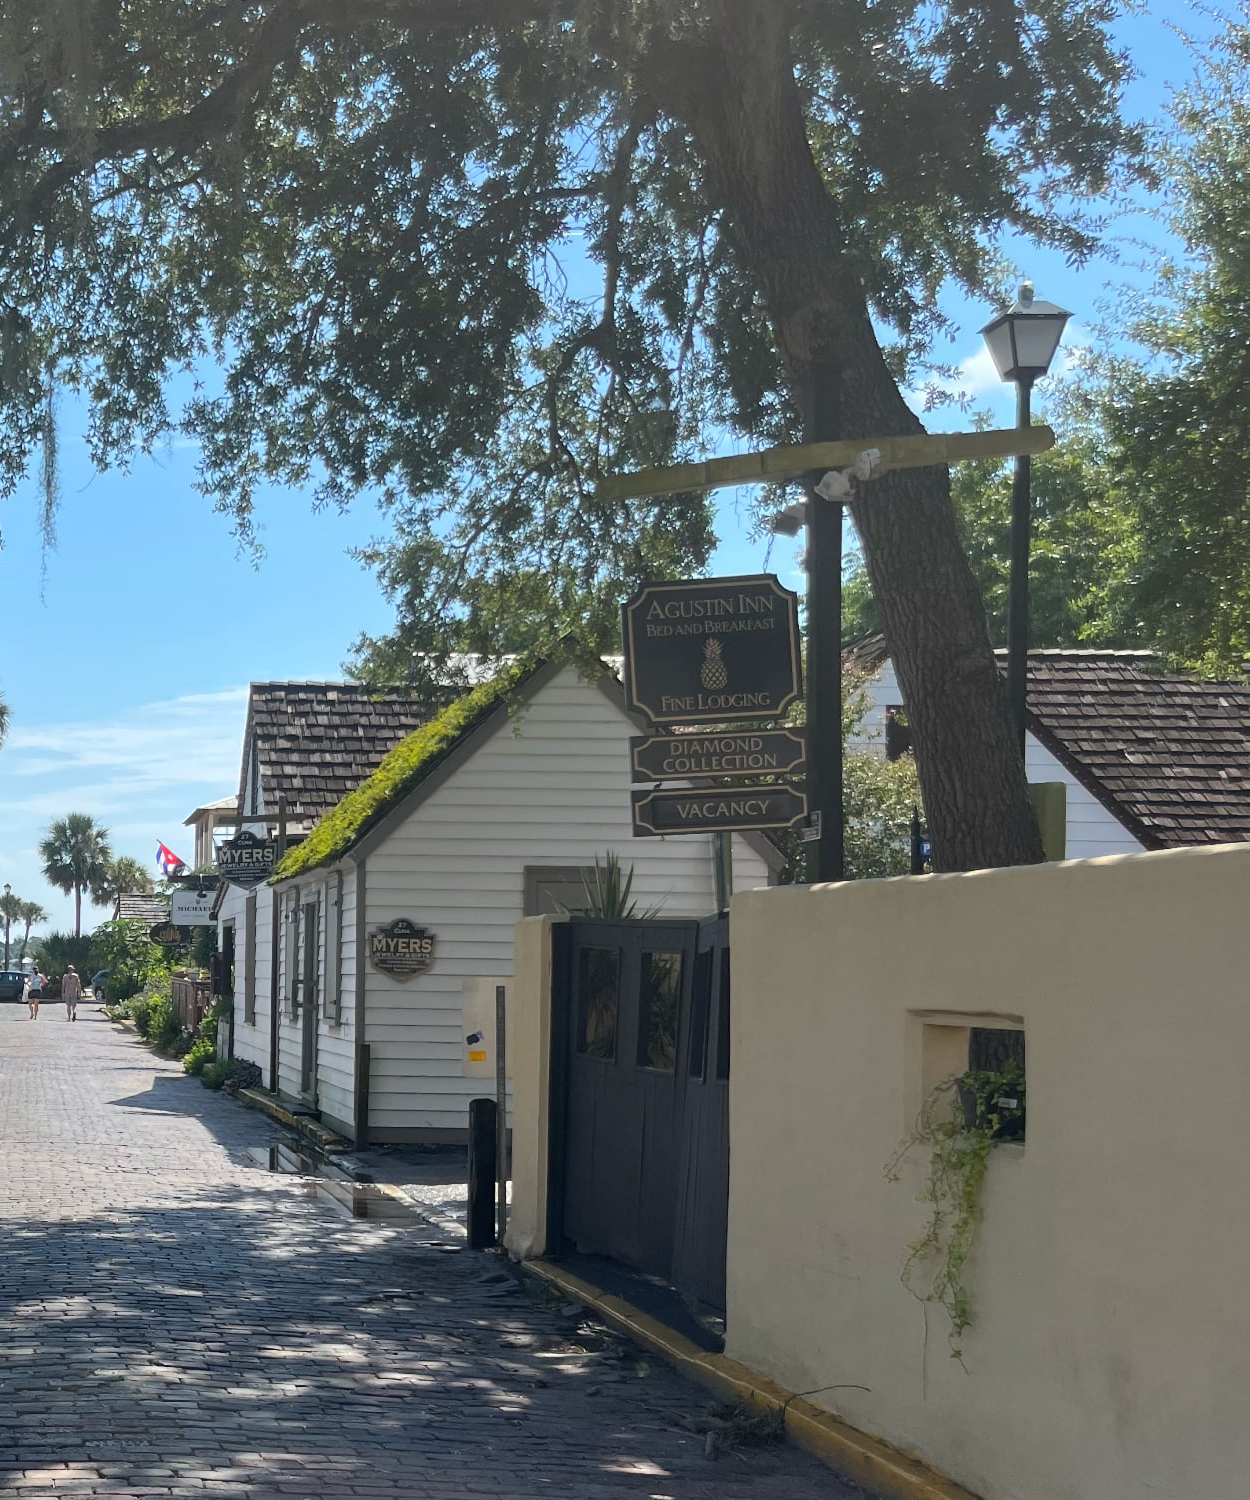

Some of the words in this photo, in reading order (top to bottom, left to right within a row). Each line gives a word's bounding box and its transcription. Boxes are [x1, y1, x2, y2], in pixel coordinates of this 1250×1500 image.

[738, 594, 775, 614] INN
[661, 695, 695, 712] FINE
[697, 692, 771, 710] LODGING
[670, 737, 764, 756] DIAMOND
[663, 753, 777, 773] COLLECTION
[677, 800, 770, 820] VACANCY
[217, 848, 274, 864] MYERS
[372, 937, 432, 953] MYERS
